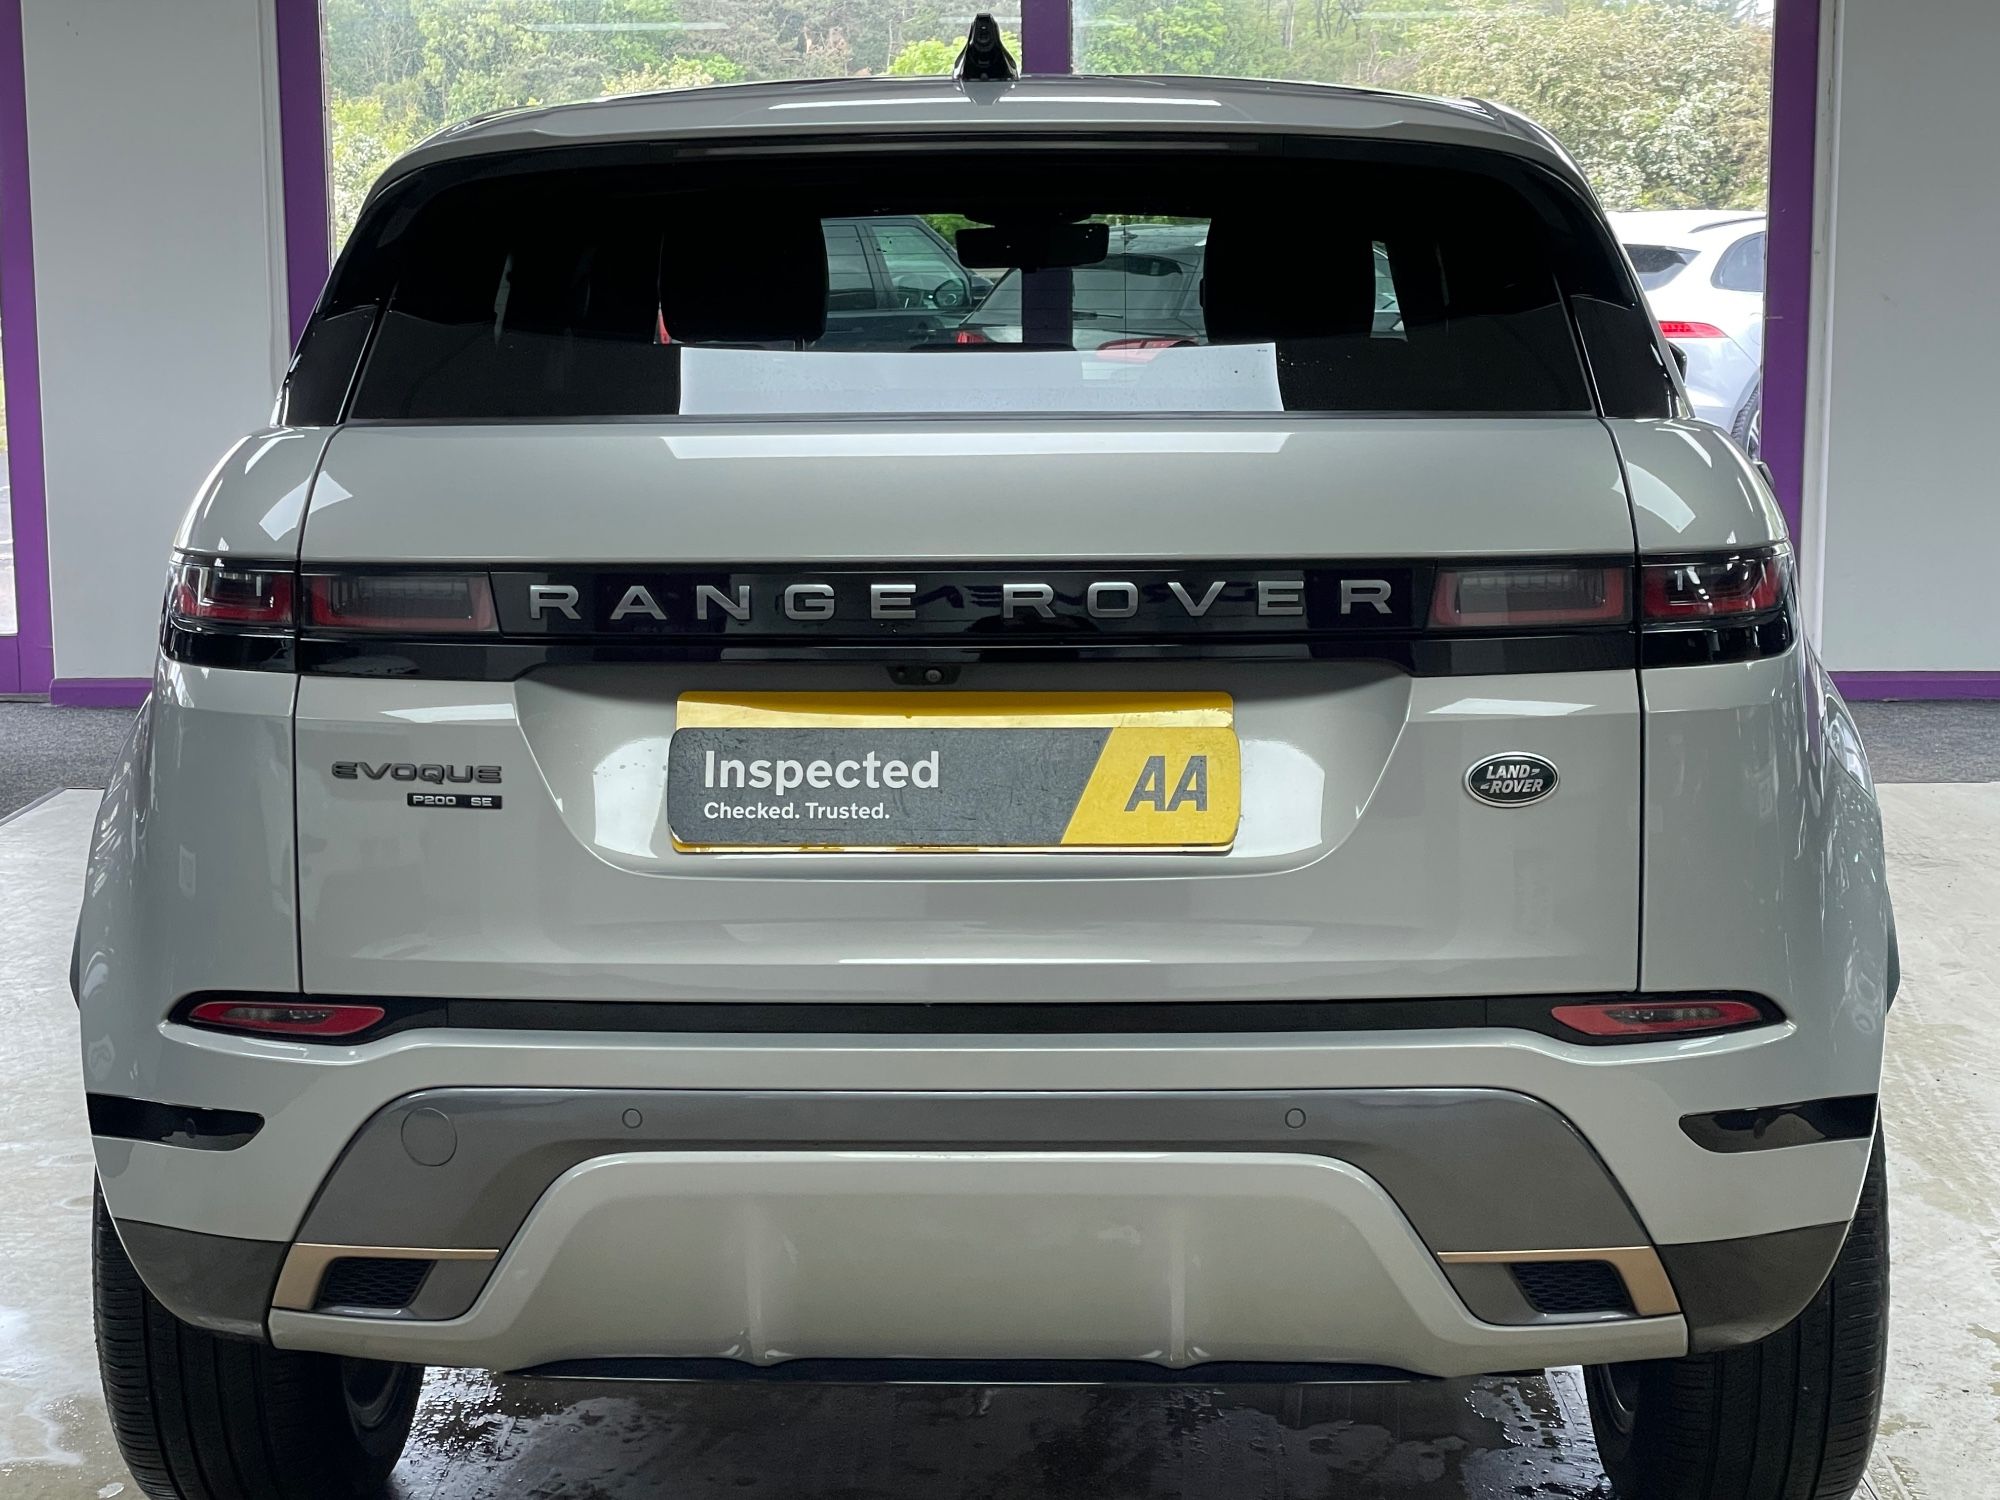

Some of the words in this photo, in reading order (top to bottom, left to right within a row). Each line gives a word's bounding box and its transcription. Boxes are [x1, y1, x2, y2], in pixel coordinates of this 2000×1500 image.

[529, 583, 917, 620] RANGE
[1002, 579, 1393, 619] ROVER
[331, 761, 502, 785] EVOQUE
[703, 750, 940, 796] Inspected
[1486, 764, 1530, 779] LAND
[1124, 755, 1207, 812] AA
[1489, 778, 1543, 794] ROVER
[412, 795, 456, 806] P200
[470, 797, 492, 807] SE
[703, 802, 799, 820] Checked.
[806, 802, 890, 820] Trusted.
